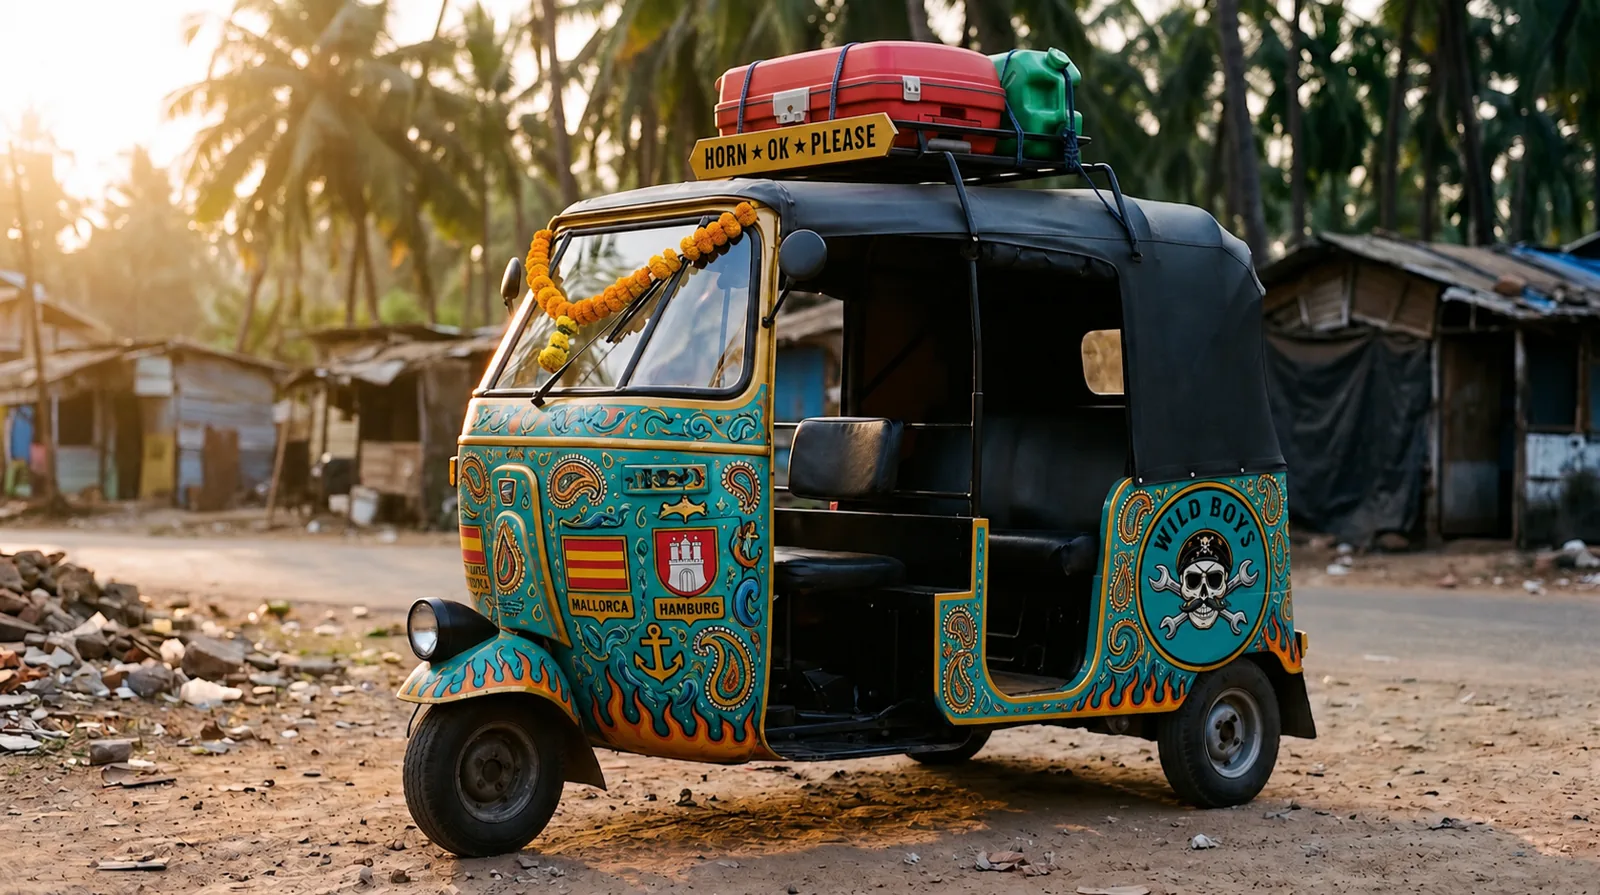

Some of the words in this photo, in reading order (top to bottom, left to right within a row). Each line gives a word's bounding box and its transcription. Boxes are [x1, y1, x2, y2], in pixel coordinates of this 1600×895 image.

[705, 143, 747, 170] HORN
[767, 136, 790, 161] OK
[811, 123, 876, 156] PLEASE
[1154, 498, 1201, 552] WILD
[1209, 496, 1256, 548] BOYS
[572, 598, 629, 613] MALLORCA
[659, 601, 720, 616] HAMBURG
